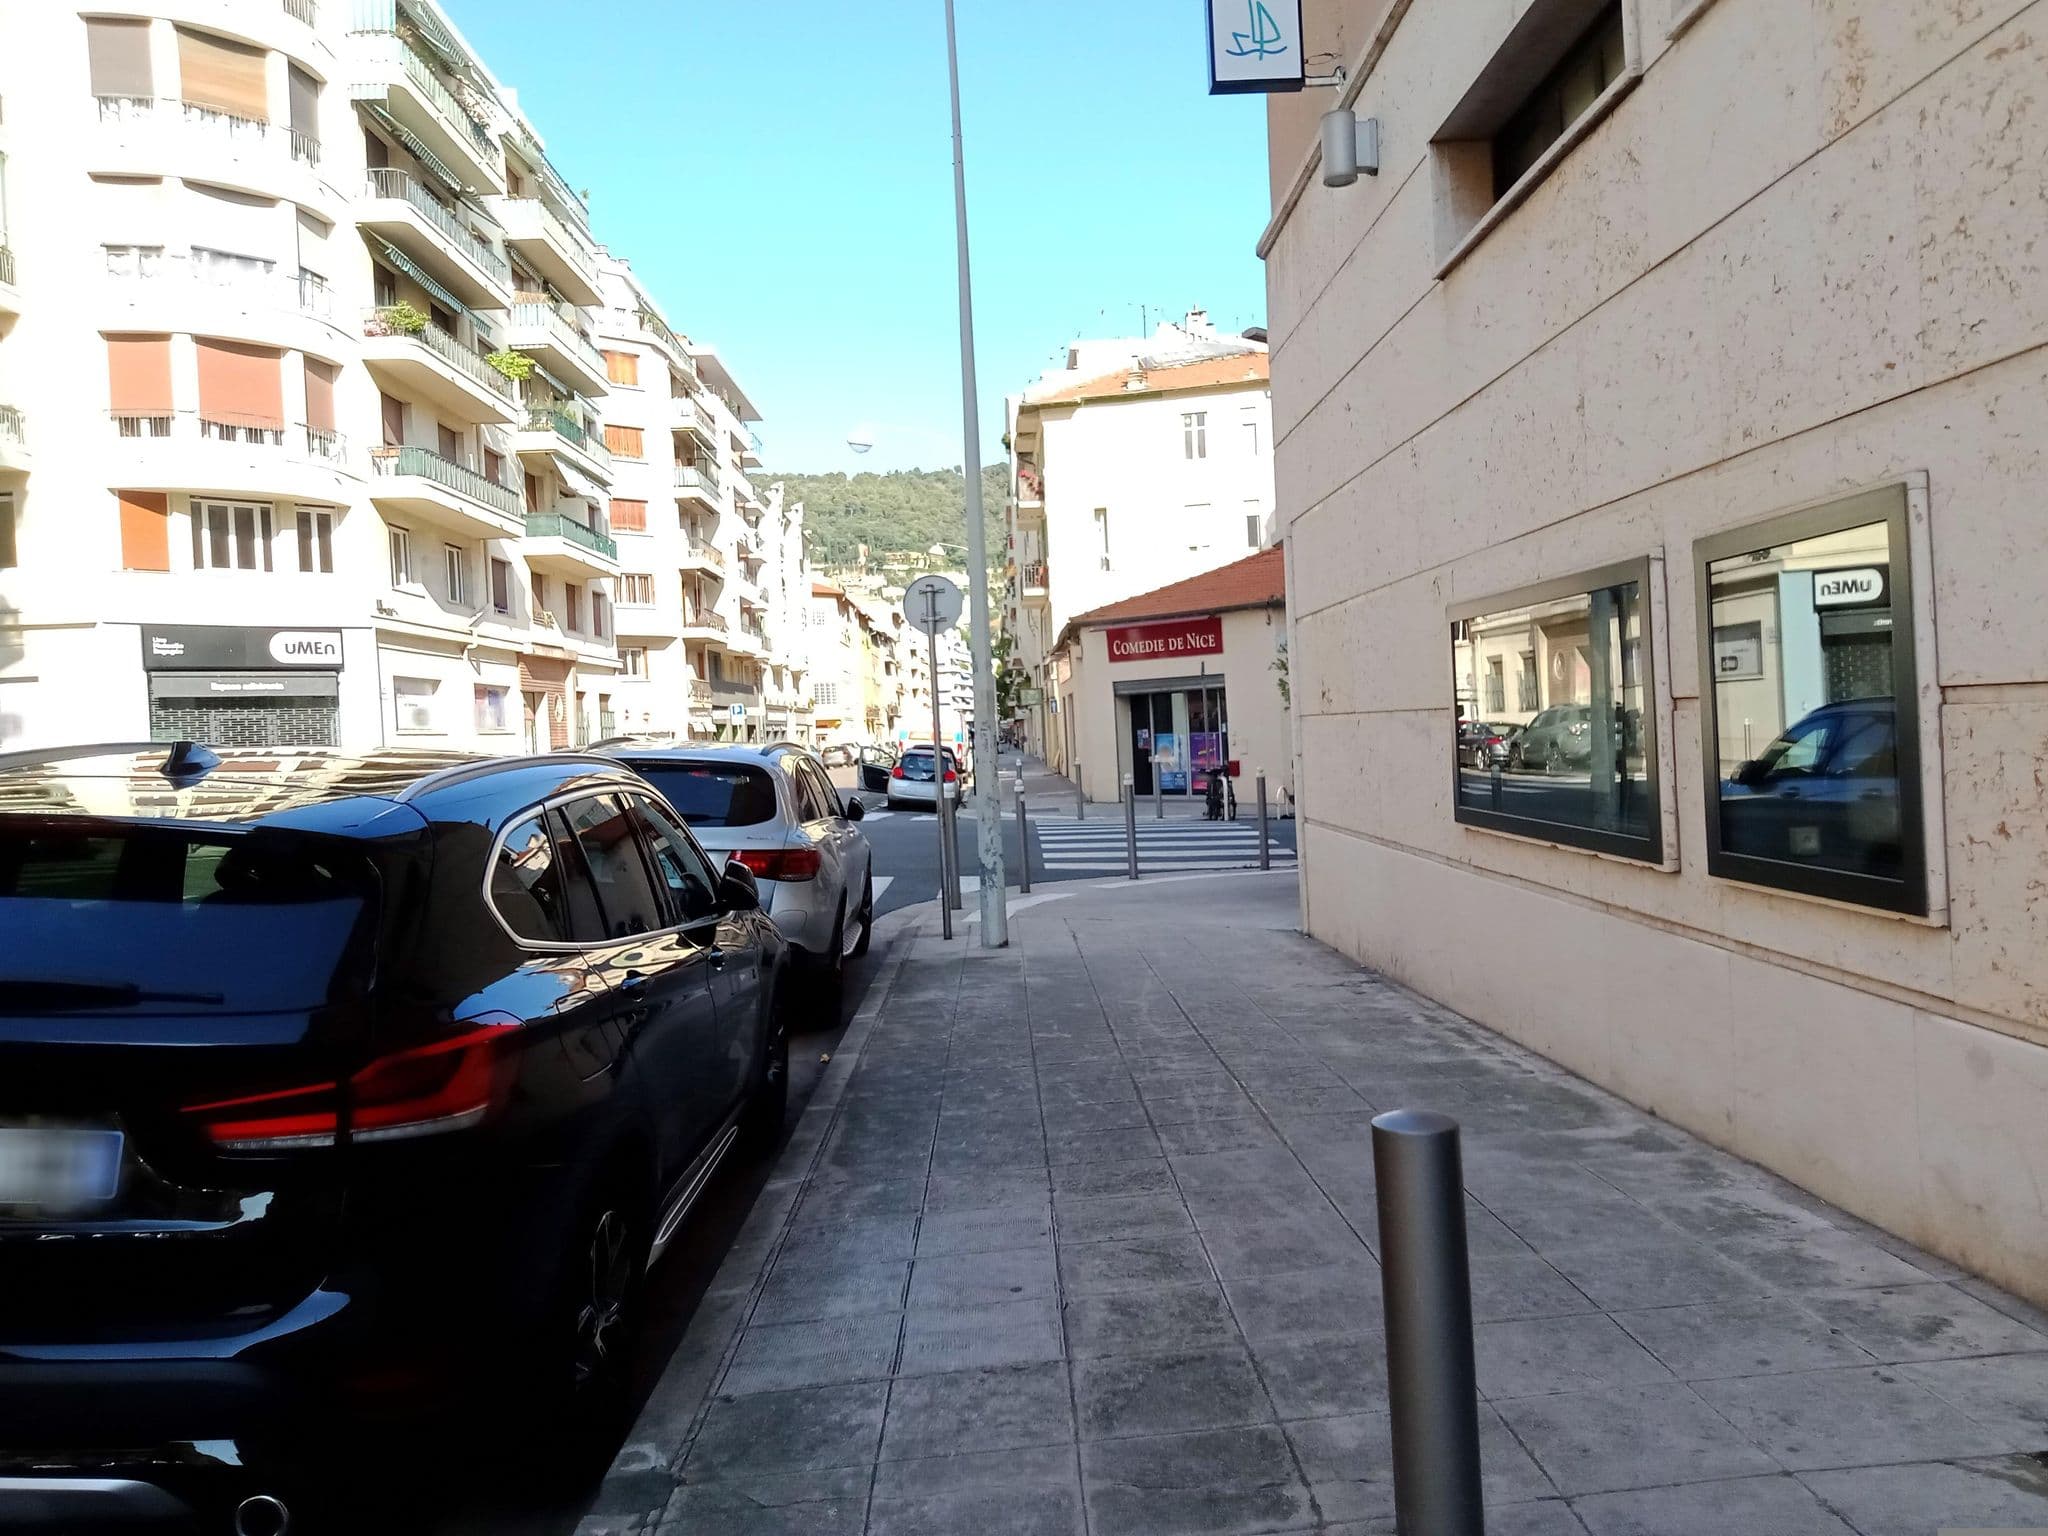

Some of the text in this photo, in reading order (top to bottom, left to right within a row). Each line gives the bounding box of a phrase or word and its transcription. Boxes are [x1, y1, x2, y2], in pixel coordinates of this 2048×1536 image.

[1113, 633, 1216, 655] COMEDIE DE NICE
